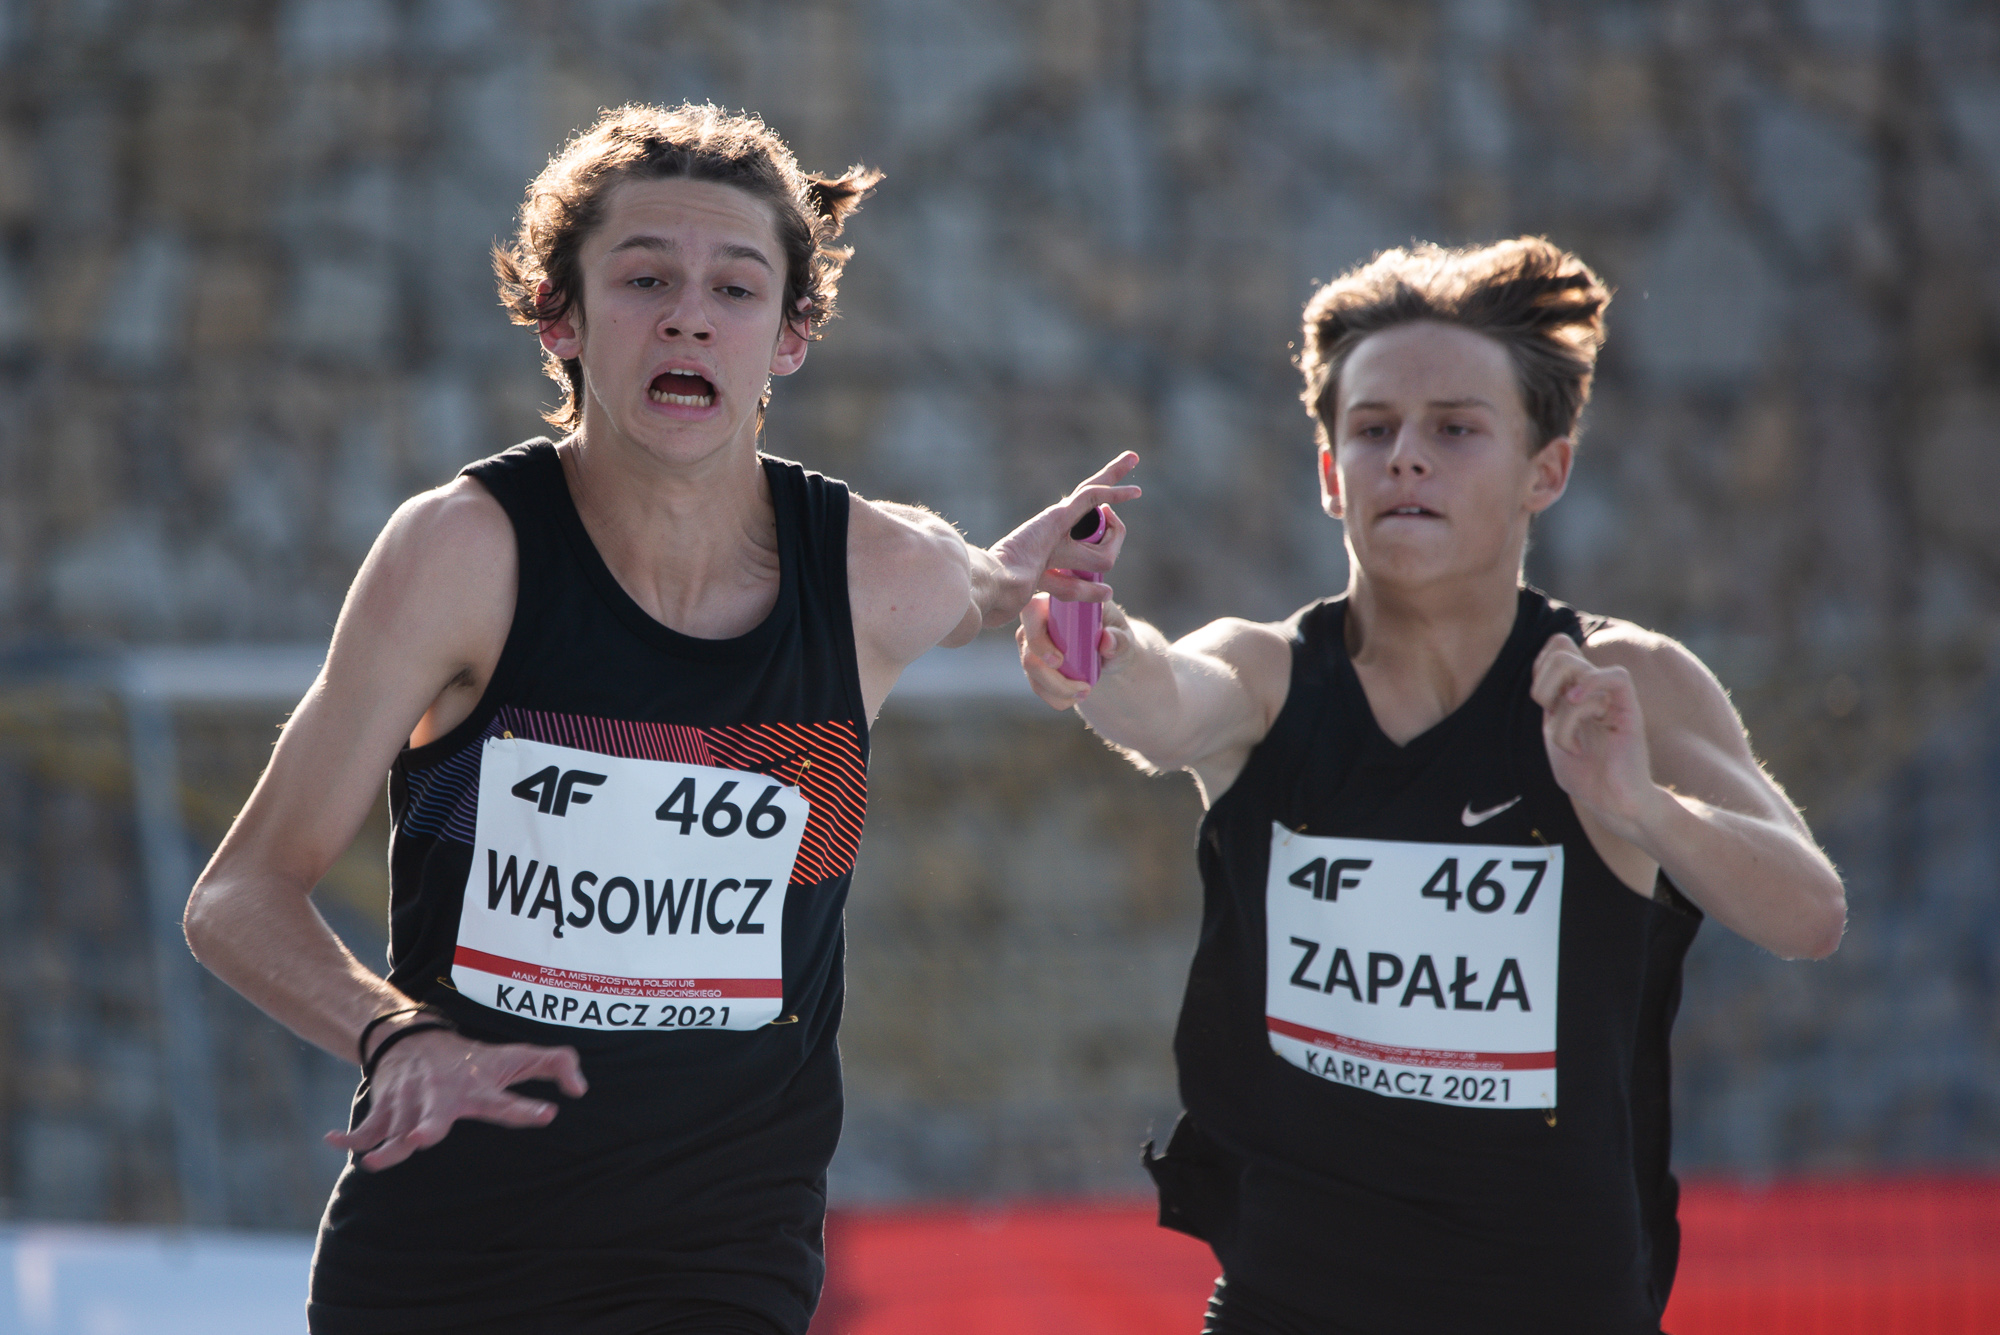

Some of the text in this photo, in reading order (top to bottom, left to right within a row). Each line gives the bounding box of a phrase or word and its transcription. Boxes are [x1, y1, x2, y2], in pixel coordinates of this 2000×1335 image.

[511, 765, 608, 817] 4F
[655, 776, 787, 839] 466
[487, 848, 773, 939] WĄSOWICZ
[1288, 857, 1373, 903] 4F
[1420, 857, 1549, 916] 467
[539, 966, 695, 988] PZLA MISTRZOSTWA POLSKI U16
[596, 985, 644, 996] JANUSZA
[1289, 935, 1533, 1012] ZAPAŁA
[496, 983, 730, 1027] KARPACZ 2021
[1305, 1049, 1434, 1097] KARPACZ
[1443, 1075, 1511, 1103] 2021
